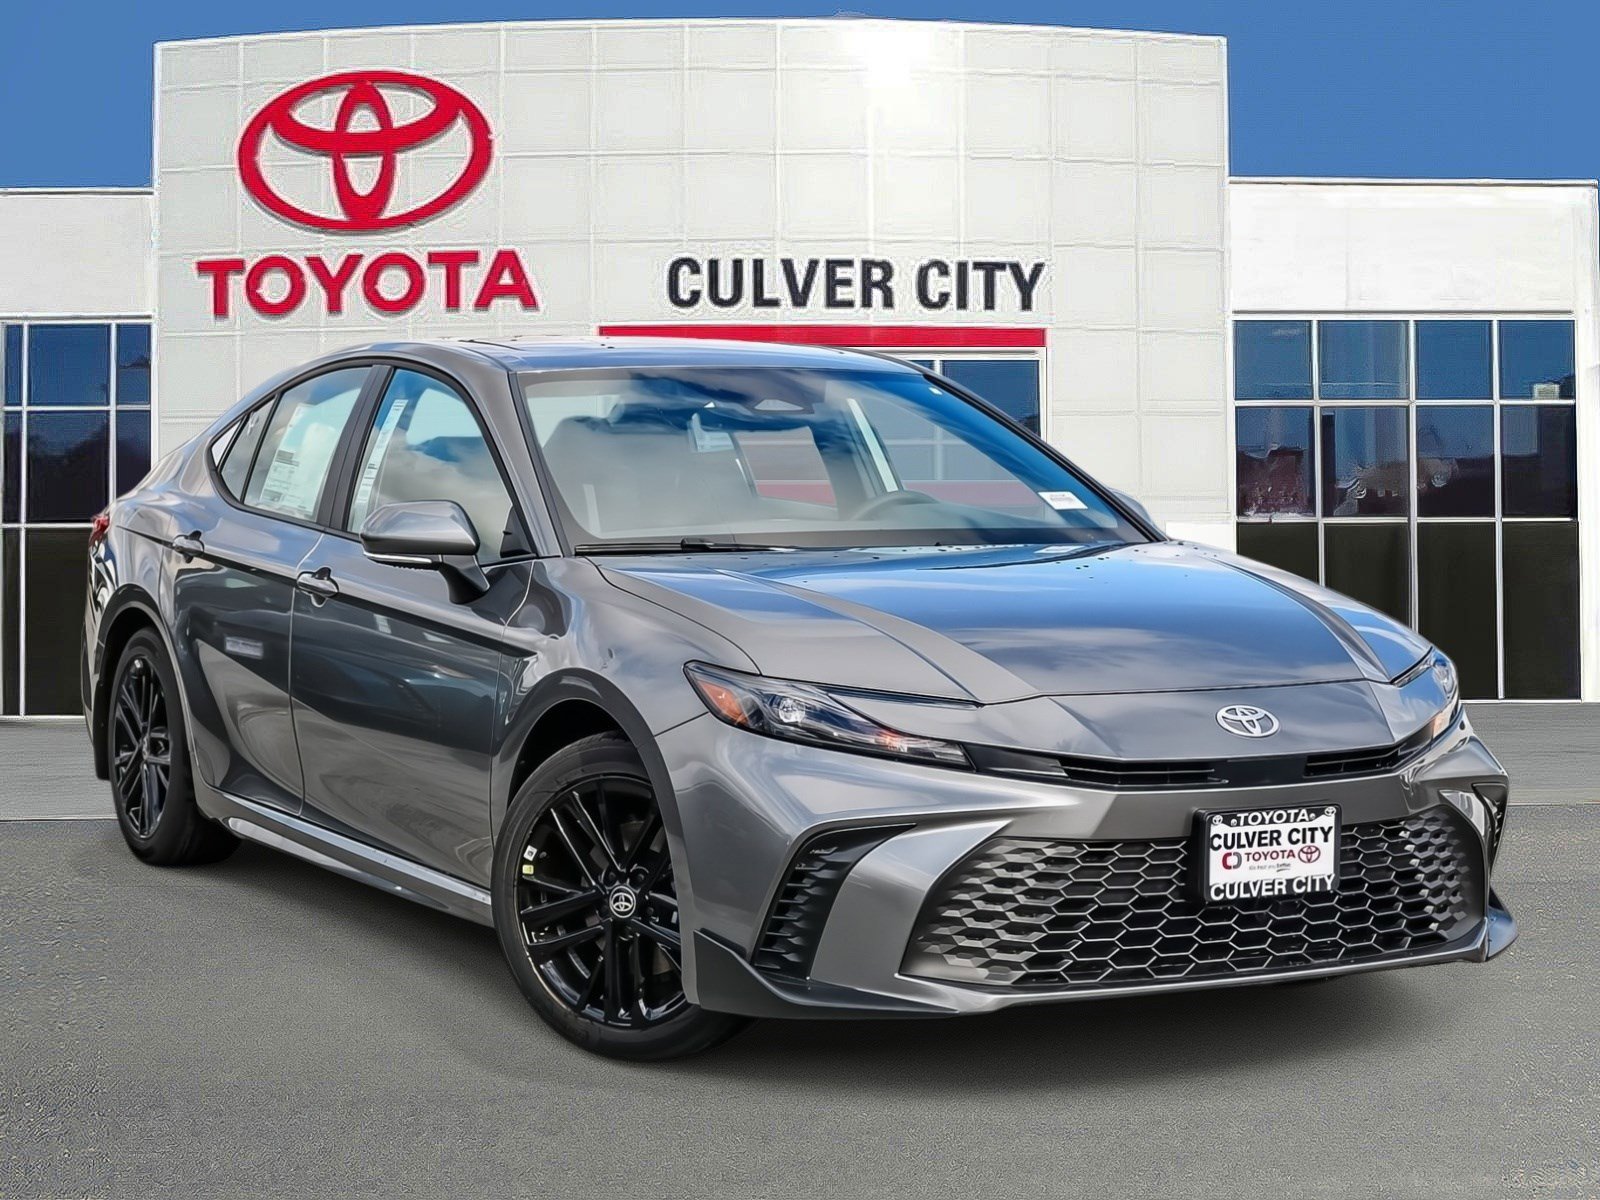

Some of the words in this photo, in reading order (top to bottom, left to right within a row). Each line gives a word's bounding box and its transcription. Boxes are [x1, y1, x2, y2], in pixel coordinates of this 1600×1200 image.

[196, 249, 538, 318] TOYOTA
[667, 257, 895, 309] CULVER
[916, 260, 1046, 311] CITY
[1237, 809, 1310, 826] TOYOTA
[1210, 830, 1282, 851] CULVER
[1287, 826, 1333, 845] CITY
[1244, 850, 1296, 862] TOYOTA
[1210, 880, 1286, 901] CULVER
[1292, 874, 1335, 893] CITY
